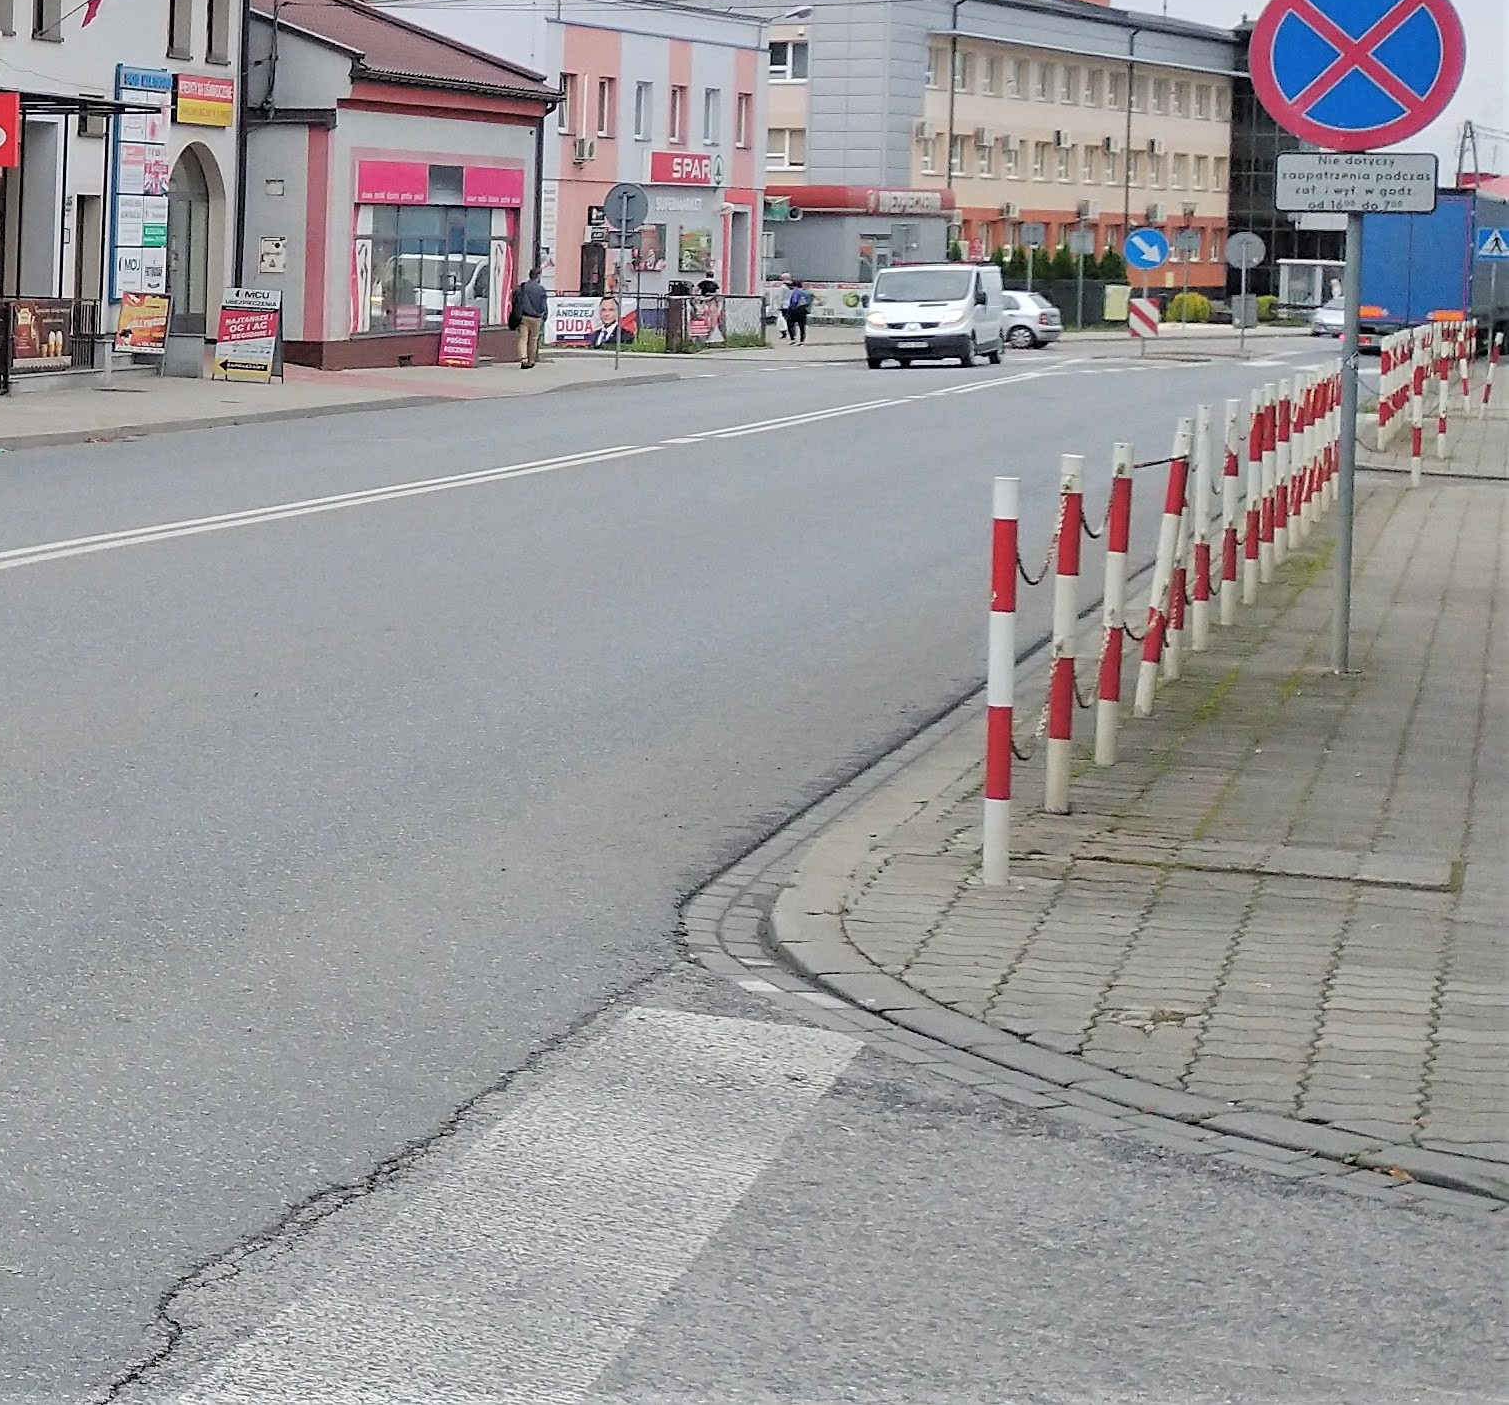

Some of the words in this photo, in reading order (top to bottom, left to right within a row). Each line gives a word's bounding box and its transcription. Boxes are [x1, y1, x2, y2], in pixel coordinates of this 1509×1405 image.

[1318, 156, 1340, 165] Nie
[1345, 155, 1395, 167] dotyczy
[673, 158, 711, 179] SPAR
[1282, 171, 1370, 182] zaopatrzenia
[1375, 171, 1431, 183] podczas
[1308, 200, 1324, 210] od
[1362, 200, 1378, 210] do
[245, 291, 269, 299] MCU
[556, 309, 595, 317] ANDRZEJ
[229, 324, 244, 333] OC
[252, 321, 268, 331] AC
[556, 319, 593, 332] DUDA
